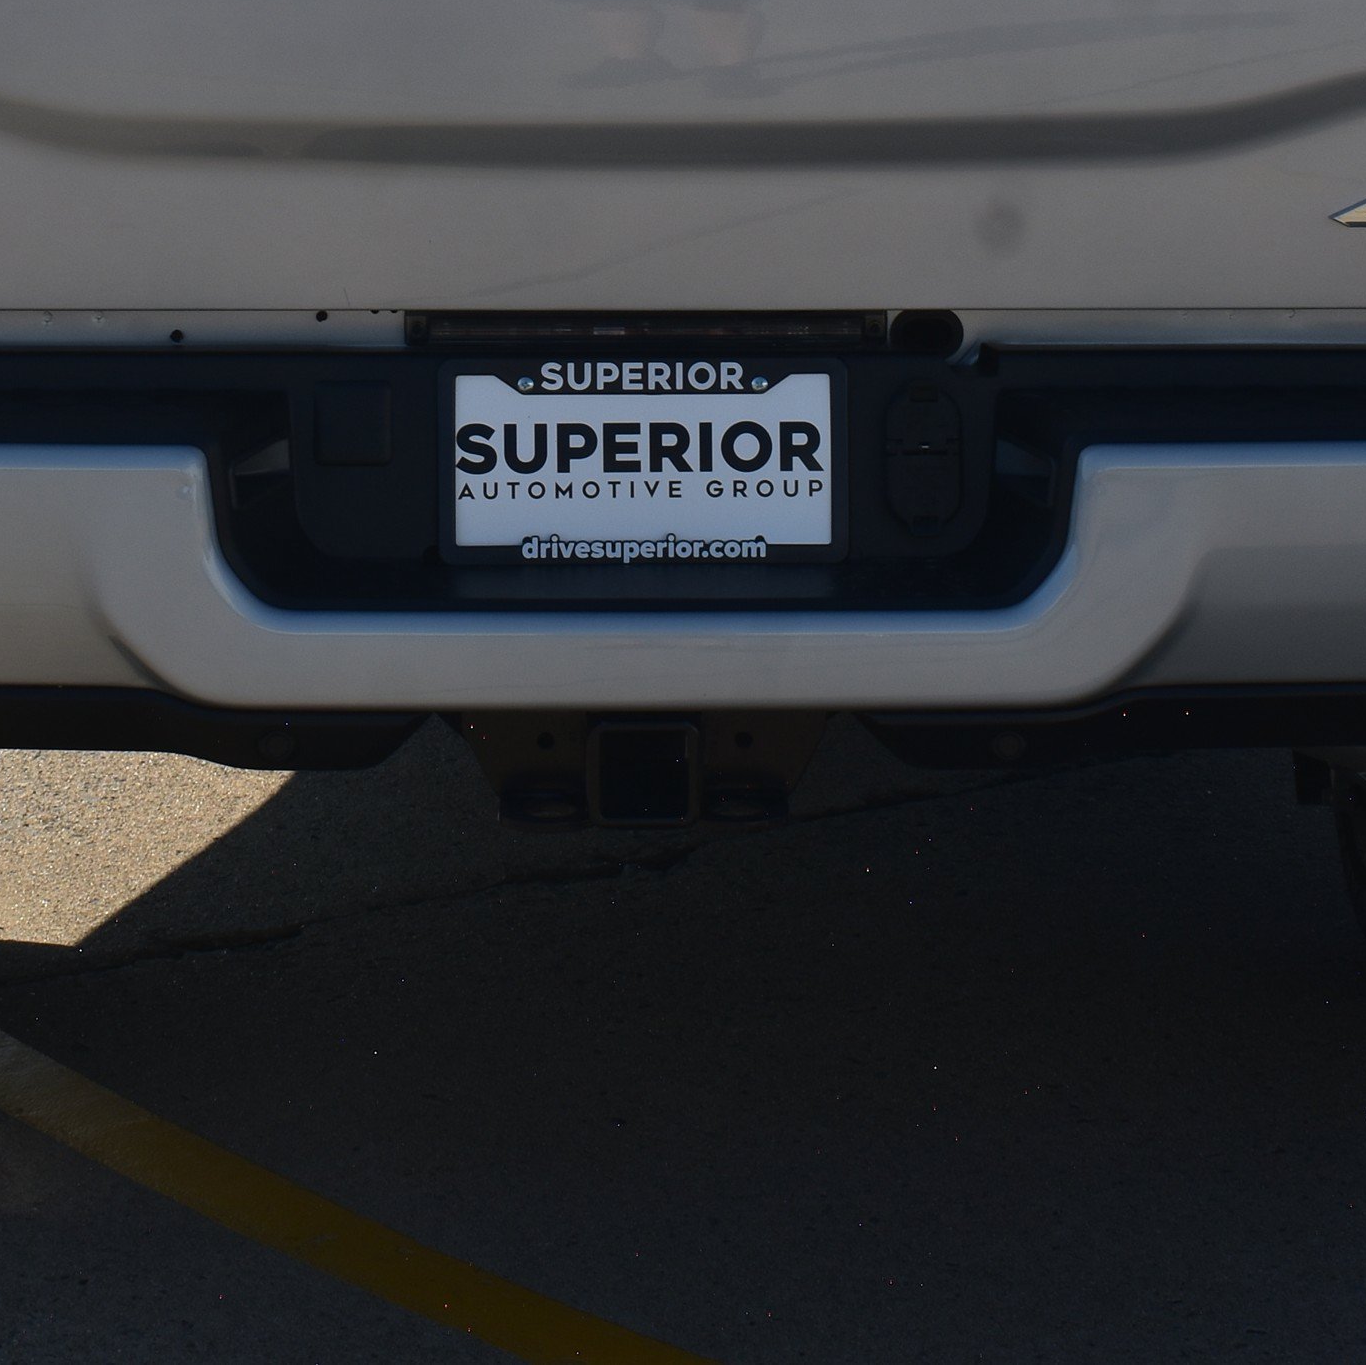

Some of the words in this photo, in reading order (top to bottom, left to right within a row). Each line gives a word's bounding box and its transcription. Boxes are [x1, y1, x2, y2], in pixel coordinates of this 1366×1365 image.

[540, 361, 745, 391] SUPERIOR
[455, 420, 825, 475] SUPERIOR
[458, 480, 682, 500] AUTOMOTIVE
[705, 479, 824, 498] GROUP
[521, 535, 767, 563] drivesuperior.com
